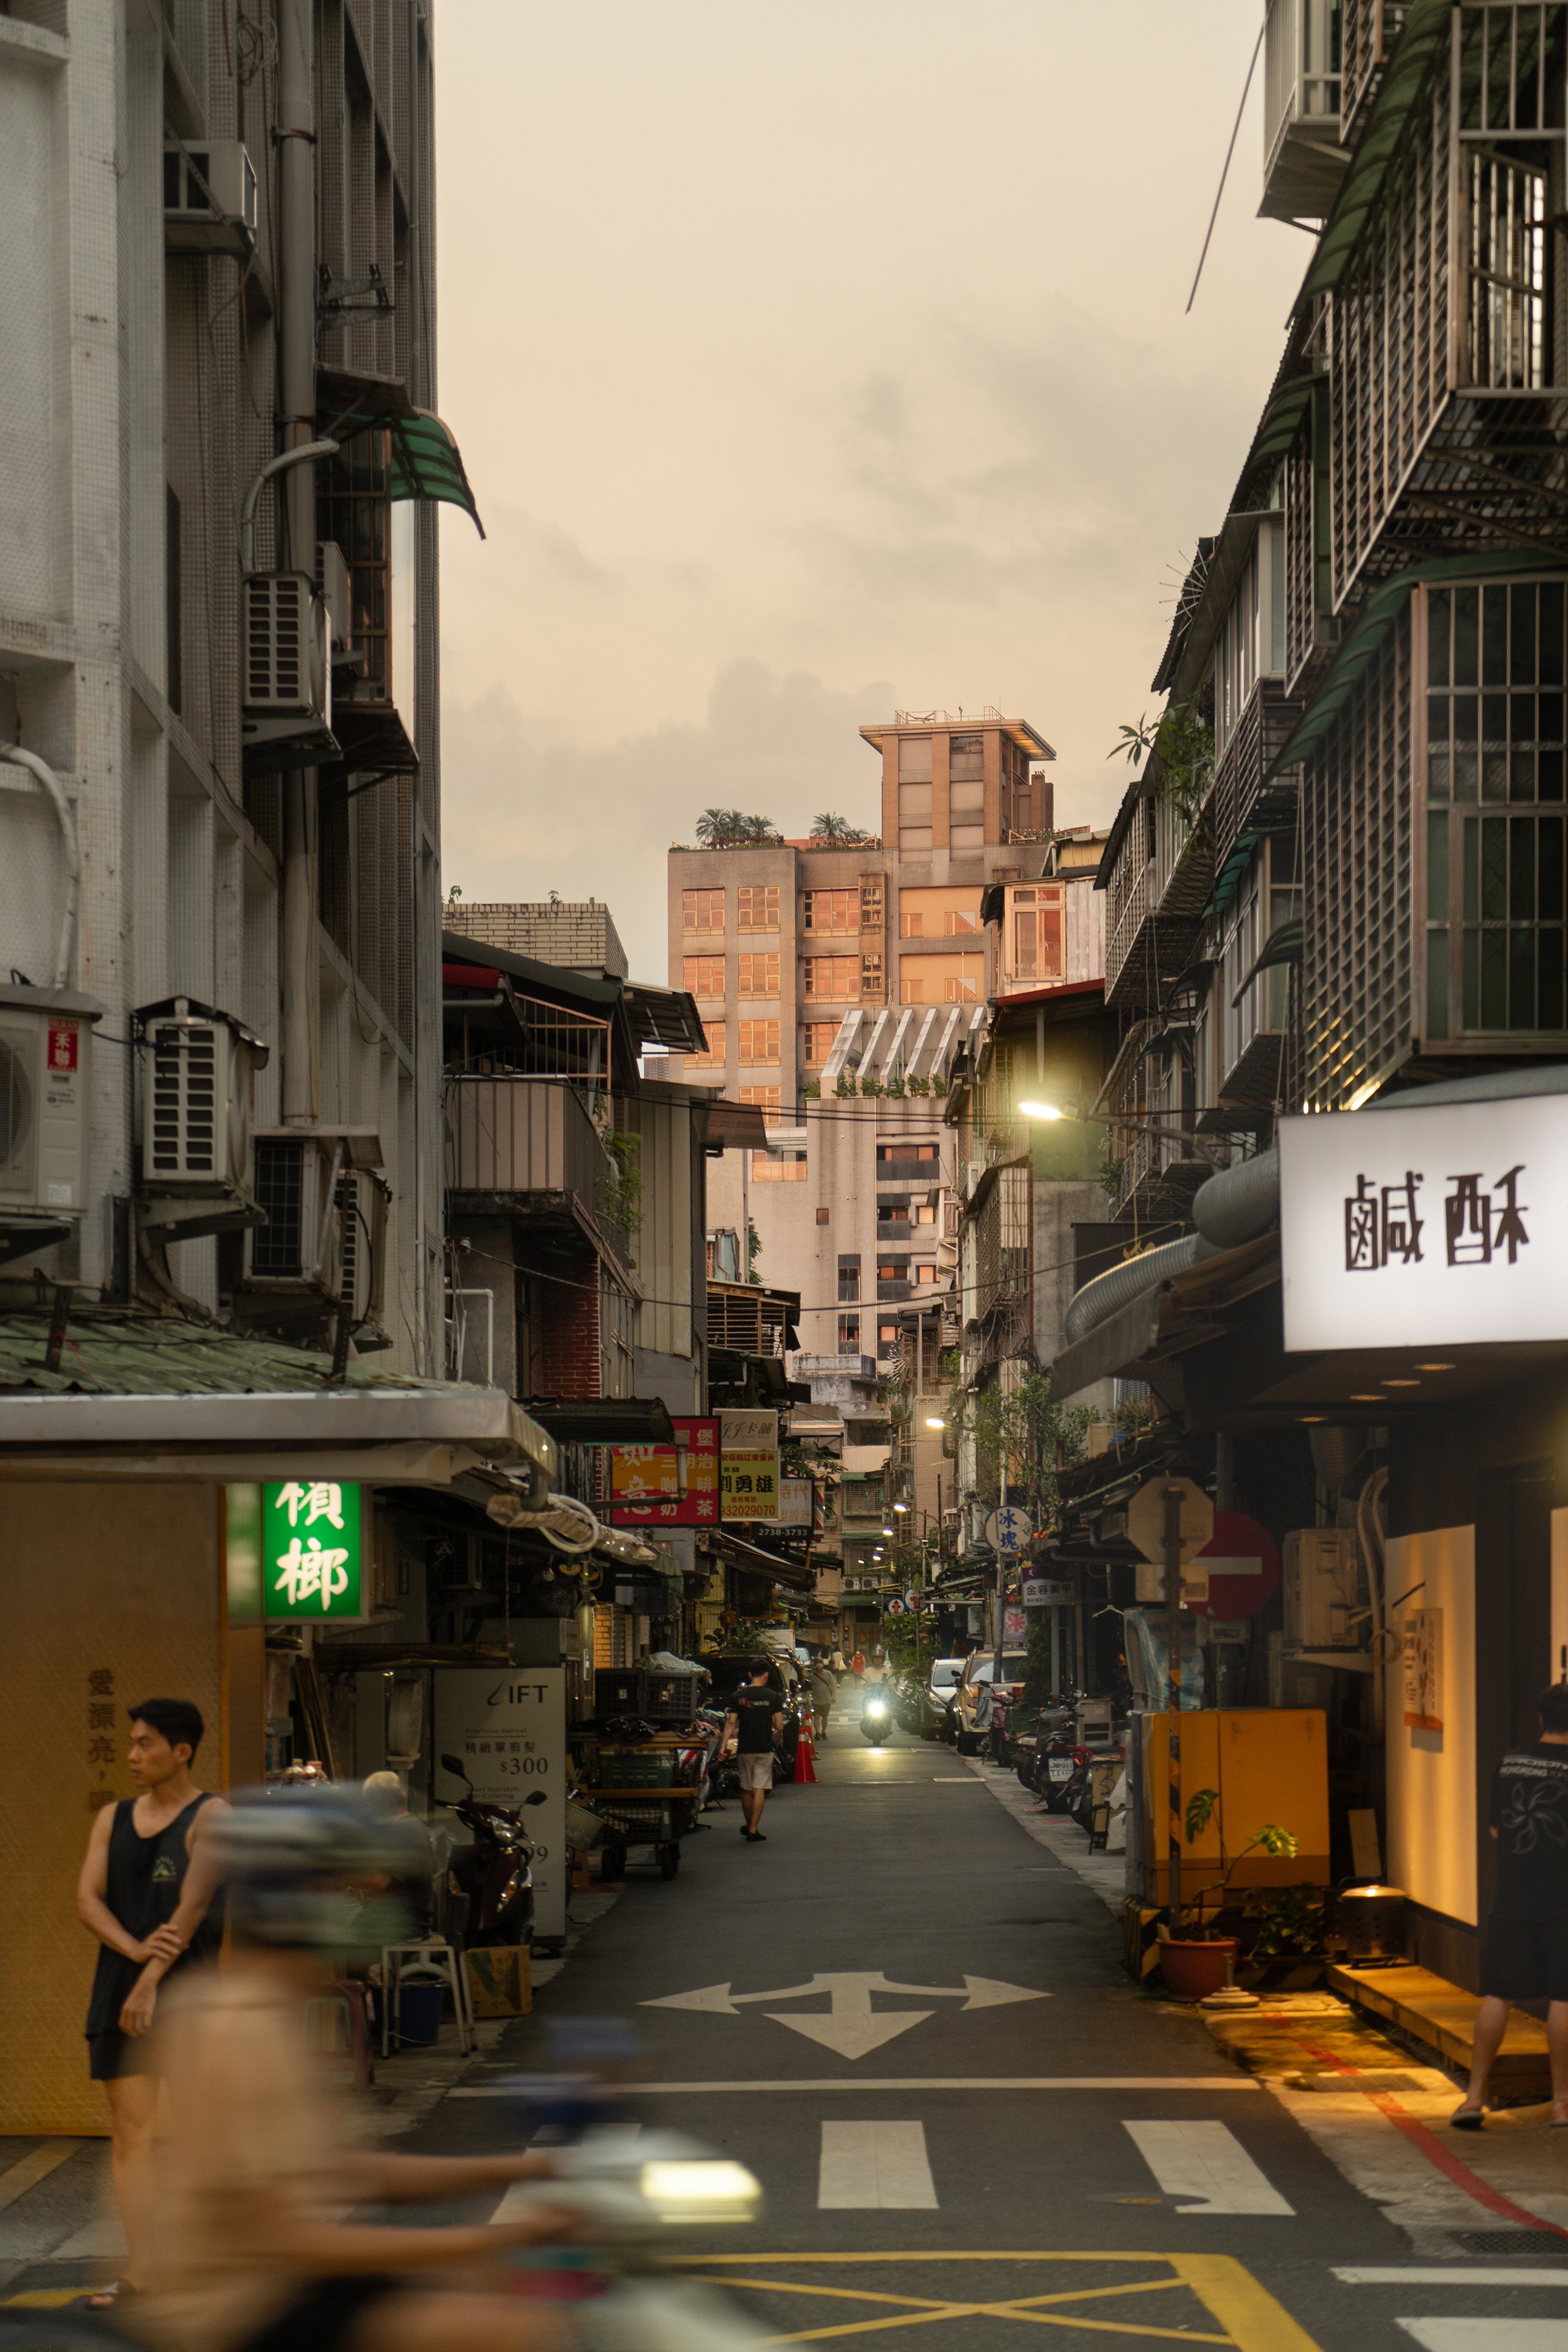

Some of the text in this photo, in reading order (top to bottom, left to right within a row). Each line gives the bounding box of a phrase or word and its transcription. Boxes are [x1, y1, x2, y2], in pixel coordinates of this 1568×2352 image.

[1345, 1165, 1530, 1272] 鹹酥
[660, 1476, 713, 1493] 咖啡
[998, 1508, 1020, 1550] 冰塊
[500, 1757, 548, 1775] $300
